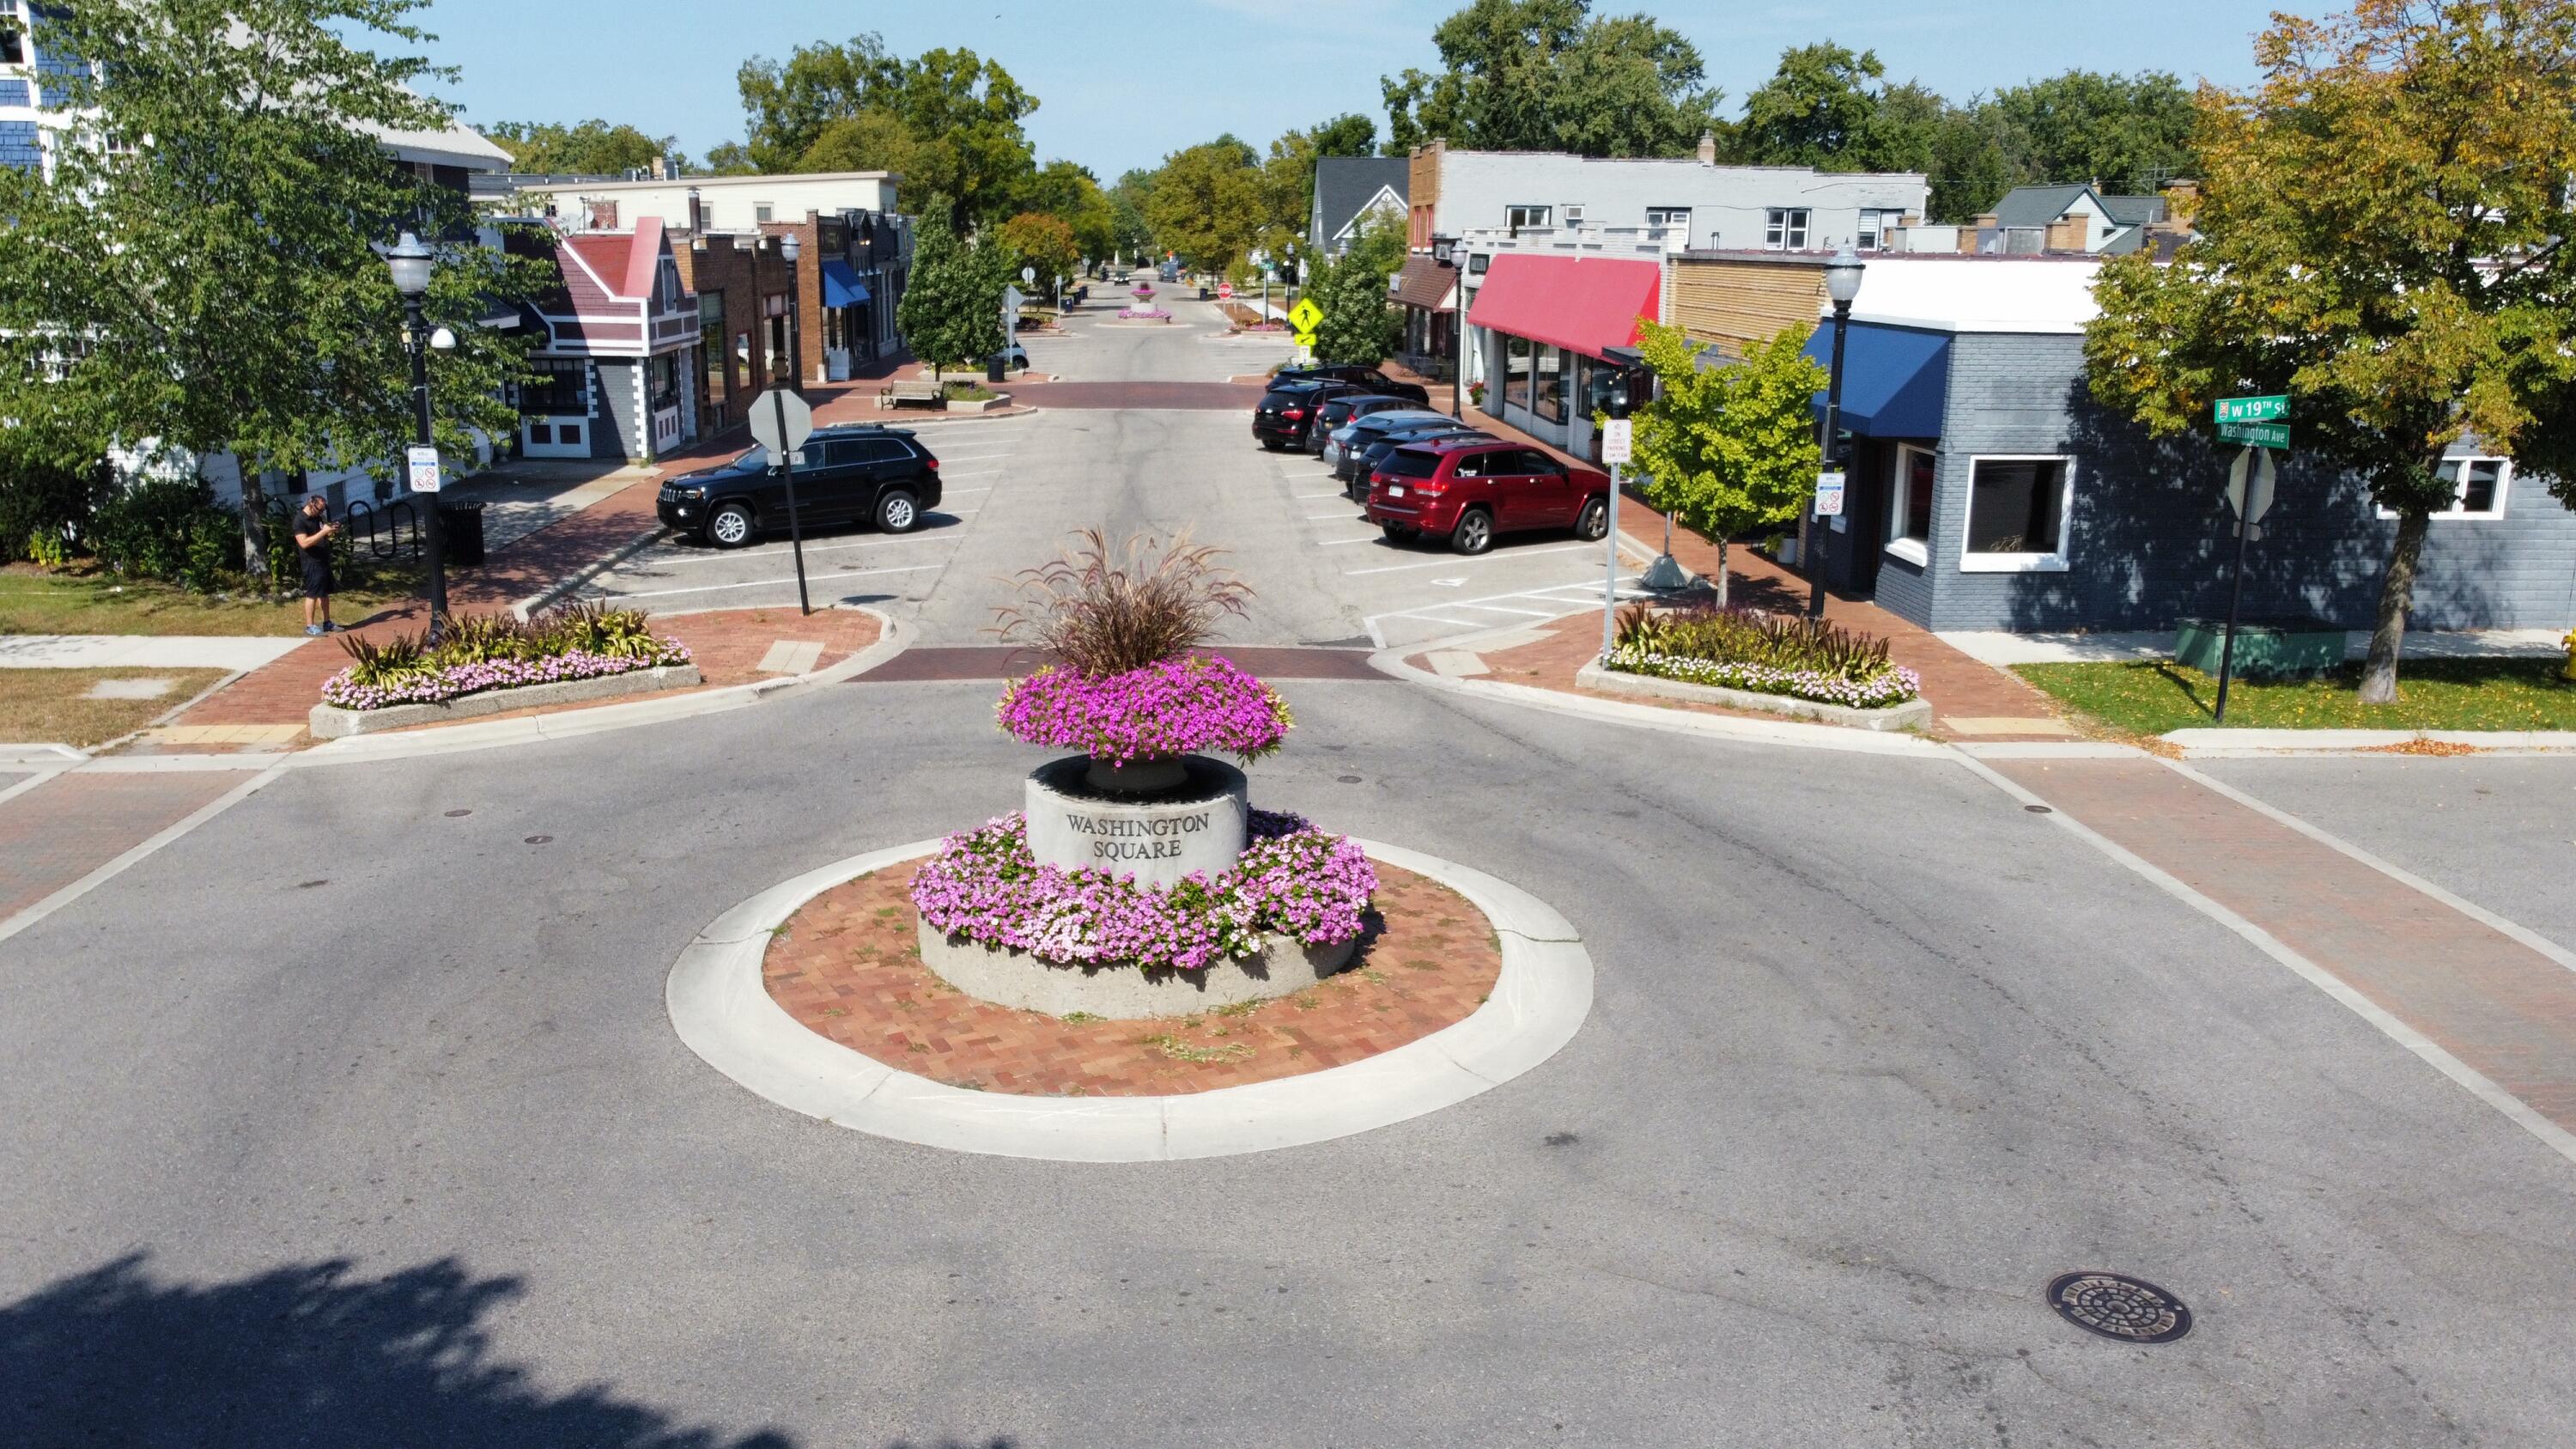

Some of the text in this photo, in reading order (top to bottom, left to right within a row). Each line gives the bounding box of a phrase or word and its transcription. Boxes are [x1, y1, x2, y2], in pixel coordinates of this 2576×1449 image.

[2232, 405, 2243, 417] W
[2245, 401, 2272, 417] 19TH
[2221, 423, 2285, 444] Washington Ave
[1066, 813, 1209, 837] WASHINGTON
[1094, 840, 1182, 861] SQUARE
